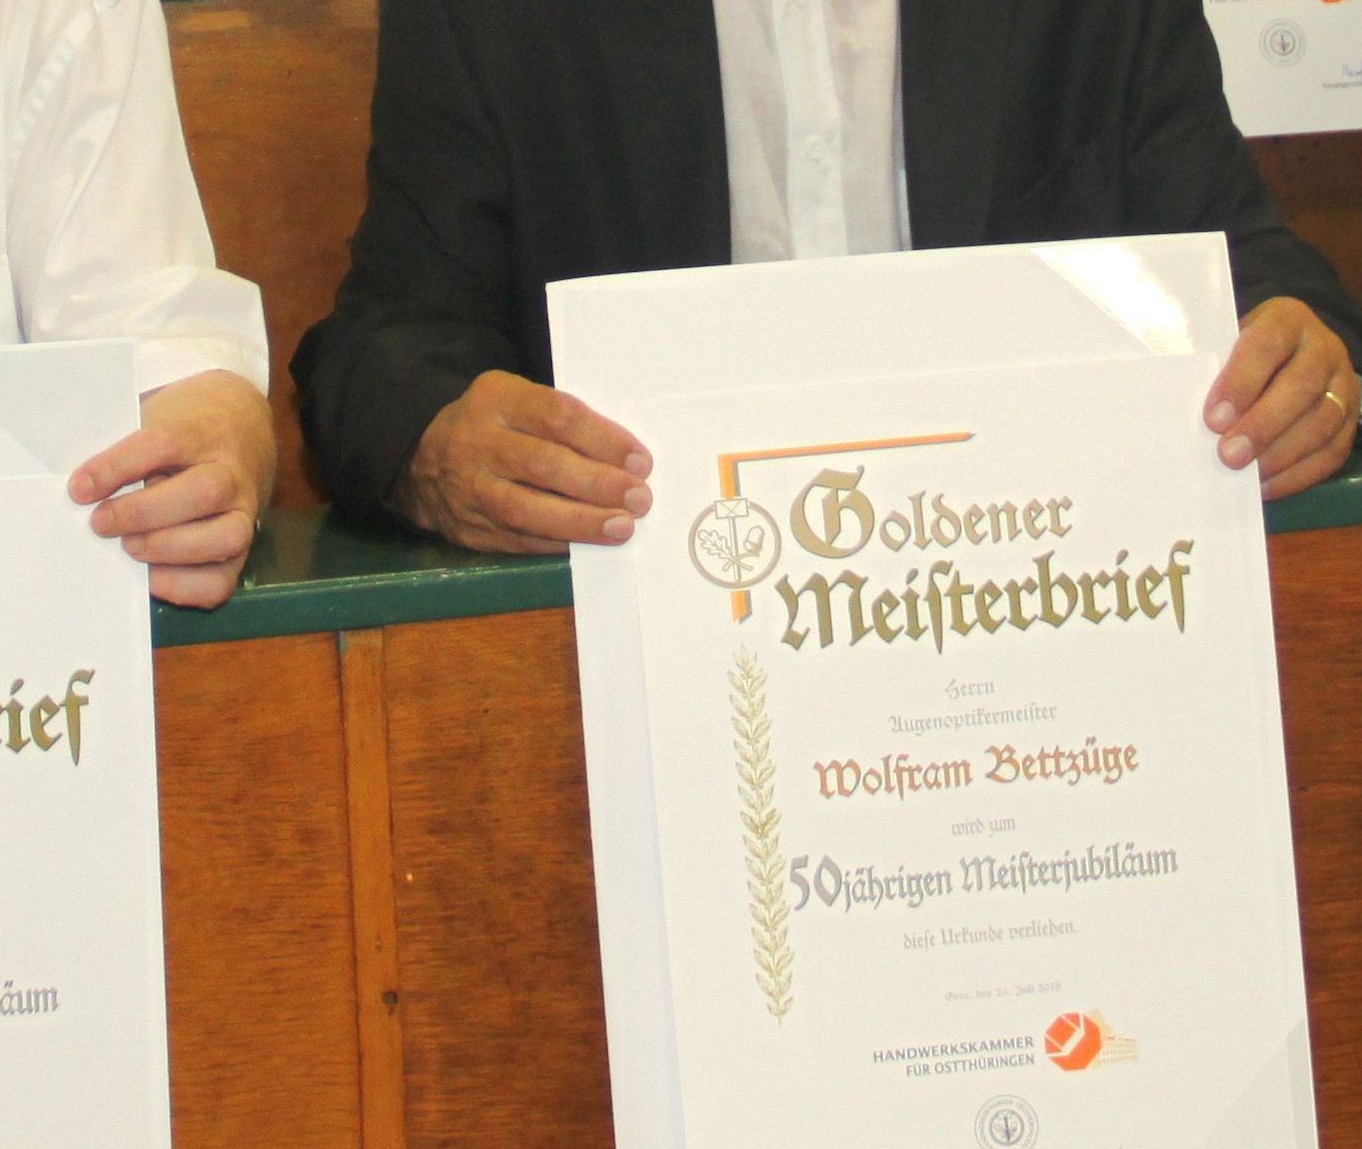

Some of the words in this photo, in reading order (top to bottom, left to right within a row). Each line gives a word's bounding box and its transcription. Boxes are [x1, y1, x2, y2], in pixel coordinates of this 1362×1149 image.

[789, 464, 1073, 561] Goldener
[945, 679, 995, 699] Herrn
[814, 754, 973, 800] Wolfram
[984, 736, 1139, 786] Bettzüge
[951, 817, 984, 837] wird
[987, 816, 1016, 836] zum
[790, 853, 952, 912] 50jährigen
[940, 925, 1003, 946] Urkunde
[873, 1035, 1034, 1063] HANDWERKSKAMMER
[906, 1060, 931, 1077] FÜR
[934, 1053, 1036, 1074] OSTTHÜRINGEN
